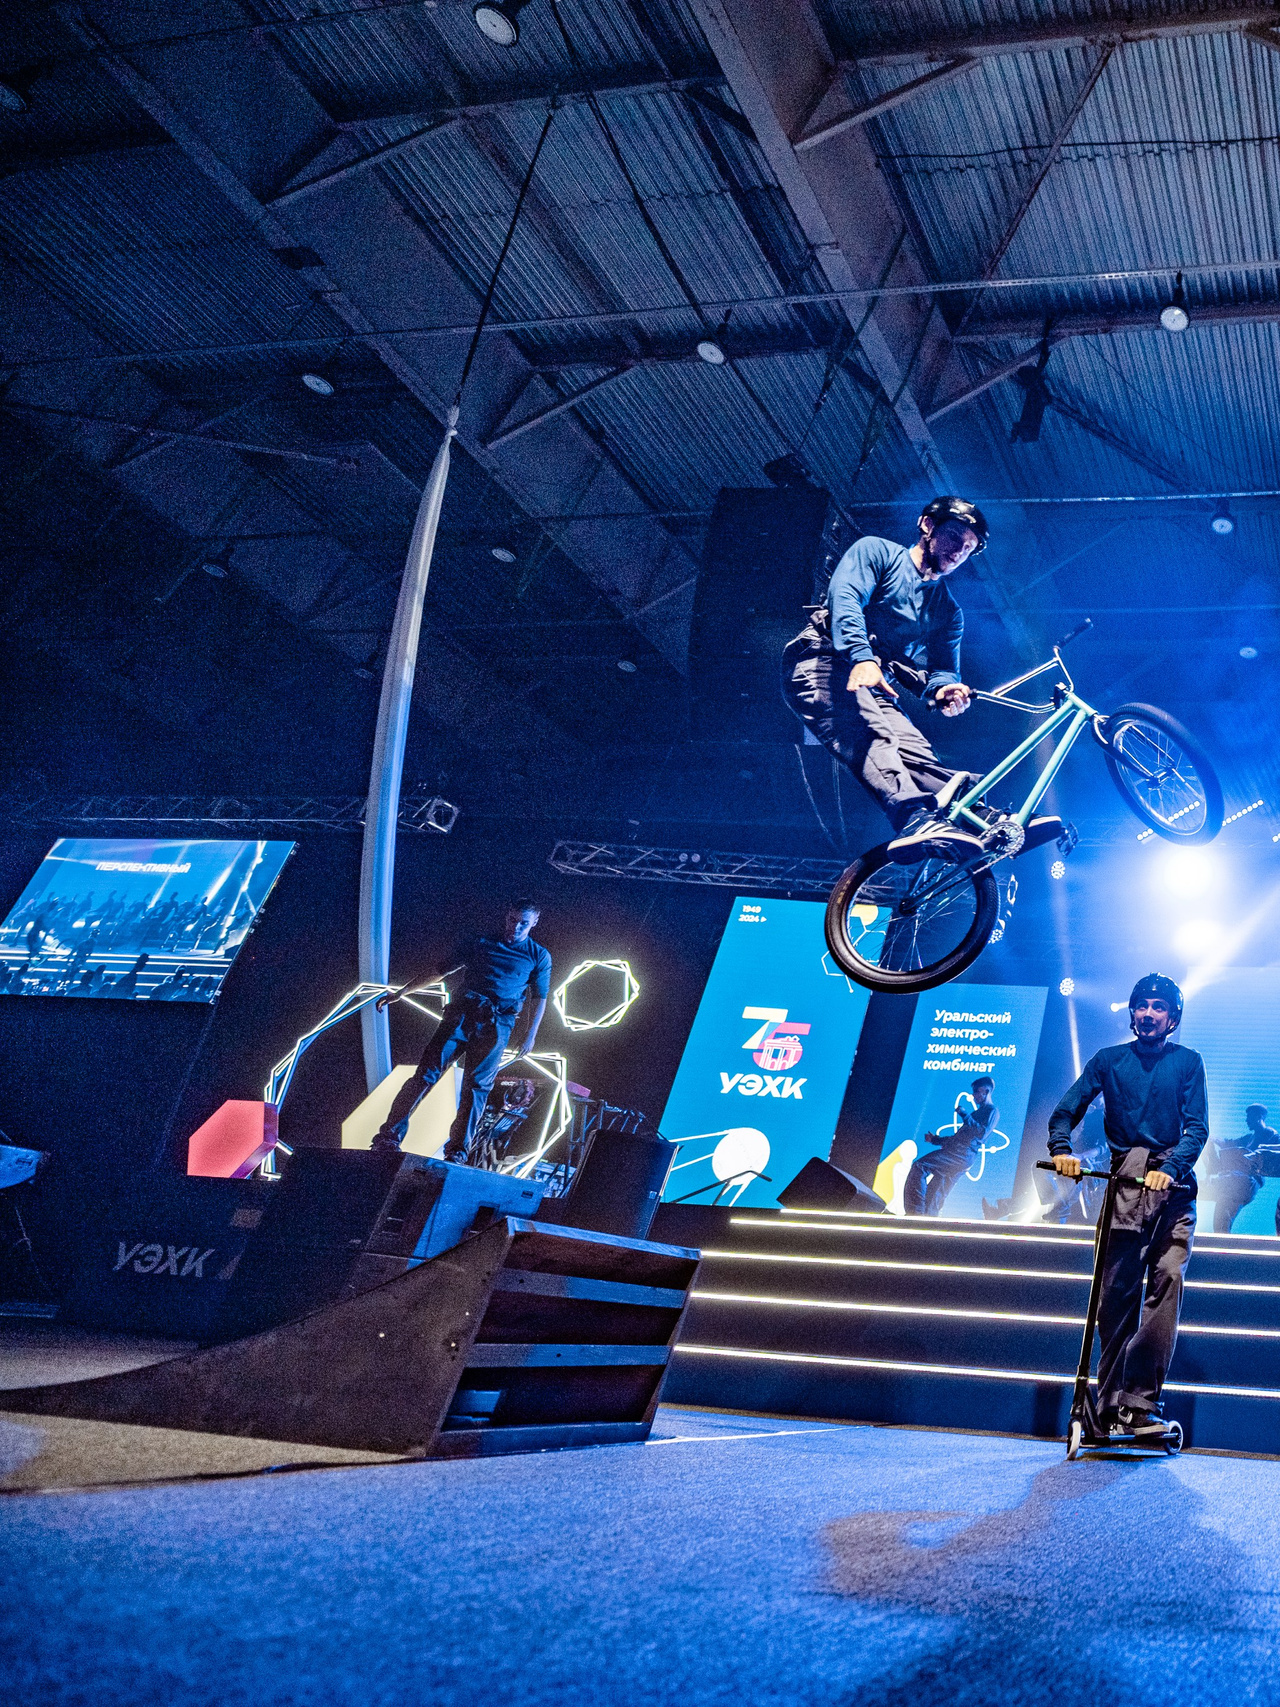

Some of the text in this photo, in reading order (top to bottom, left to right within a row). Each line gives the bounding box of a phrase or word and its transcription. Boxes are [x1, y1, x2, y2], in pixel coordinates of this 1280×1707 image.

[95, 861, 192, 874] ПЕРСПЕКТИВНЫЙ
[738, 914, 760, 923] 2024
[934, 1009, 1012, 1024] Уральский
[741, 1005, 811, 1072] 75
[930, 1027, 994, 1041] электро-
[926, 1043, 1017, 1057] химический
[923, 1058, 996, 1073] комбинат
[719, 1072, 808, 1100] УЭХК
[112, 1241, 216, 1278] УЭХК
